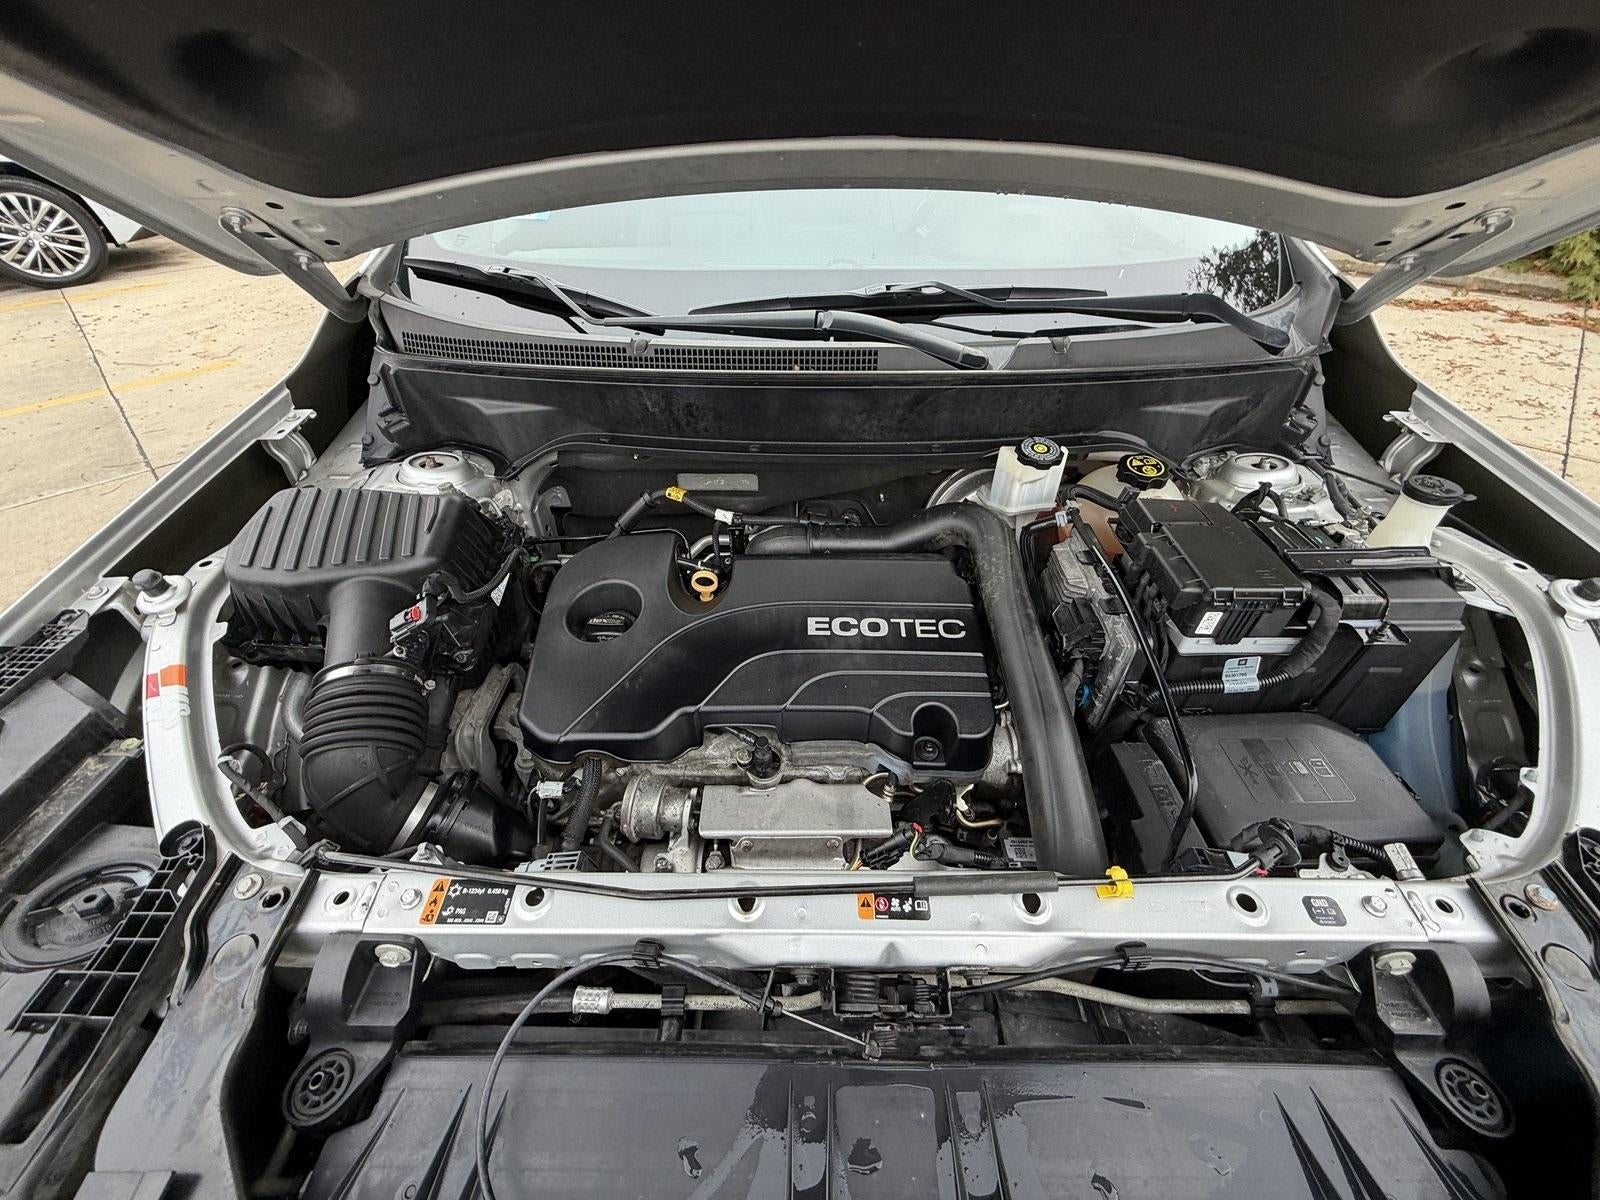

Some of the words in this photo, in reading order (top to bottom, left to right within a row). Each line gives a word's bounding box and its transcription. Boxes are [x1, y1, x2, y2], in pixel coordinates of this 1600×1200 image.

[807, 616, 966, 638] ECOTEC
[1311, 899, 1329, 907] GND
[455, 907, 466, 915] PAG
